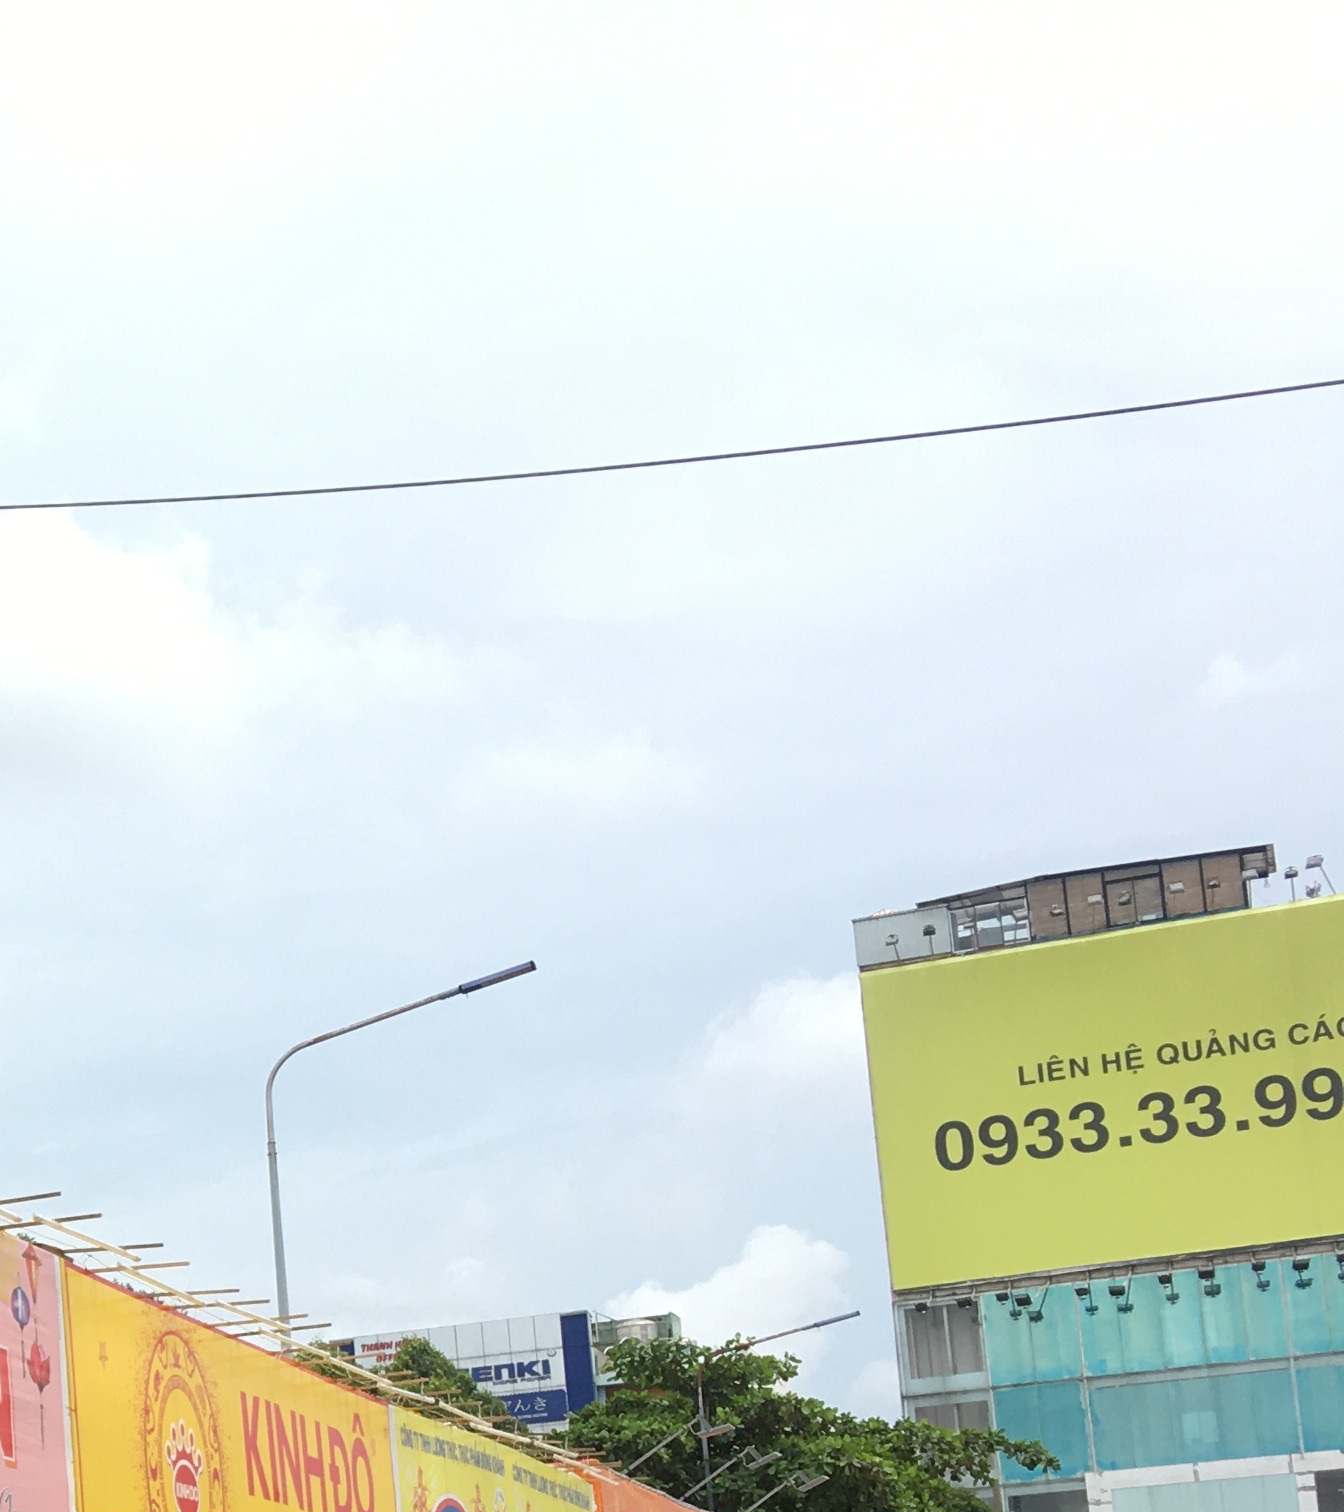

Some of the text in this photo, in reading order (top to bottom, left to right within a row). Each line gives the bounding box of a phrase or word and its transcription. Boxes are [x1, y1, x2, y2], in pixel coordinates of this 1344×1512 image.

[1018, 1054, 1089, 1086] LIÊN
[1101, 1043, 1145, 1075] HỆ
[1156, 1028, 1277, 1066] QUẢNG
[934, 1066, 1344, 1171] 0933.33.99
[455, 1359, 551, 1382] ENKI
